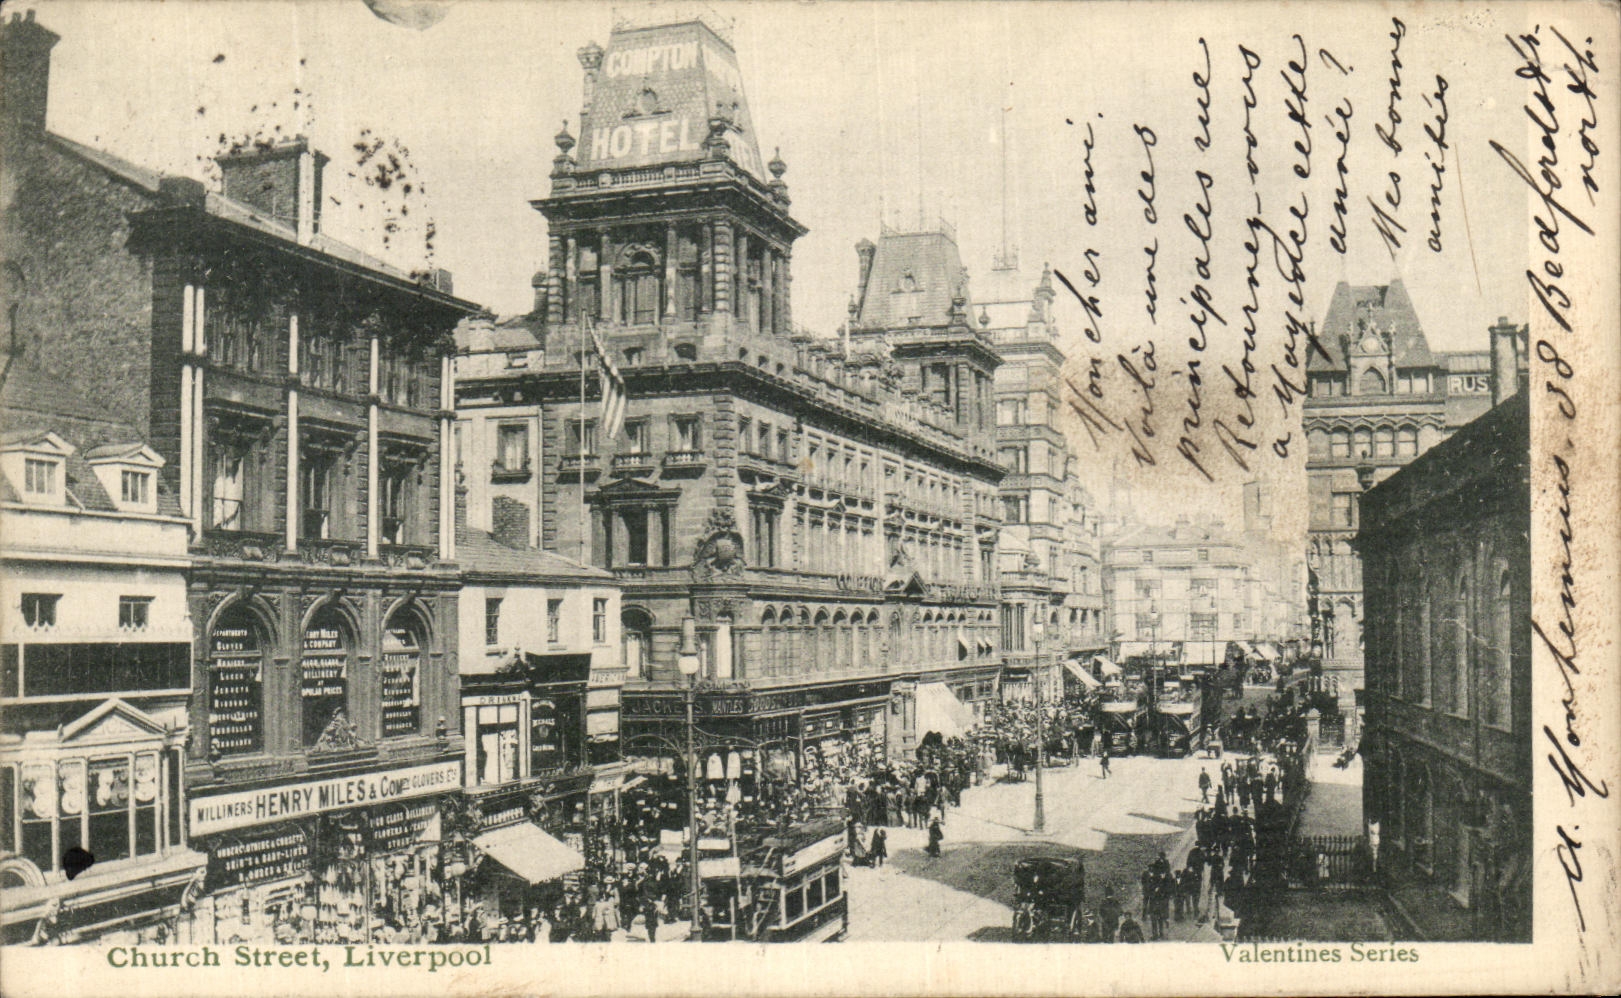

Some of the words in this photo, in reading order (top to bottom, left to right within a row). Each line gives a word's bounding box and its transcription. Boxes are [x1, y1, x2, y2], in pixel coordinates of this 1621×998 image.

[606, 41, 698, 78] COMPTON
[1280, 34, 1312, 178] cette
[1375, 14, 1406, 155] bonnes
[590, 117, 700, 161] HOTEL
[1133, 123, 1157, 223] des
[1367, 170, 1402, 259] Mes
[1055, 249, 1102, 342] cher
[1142, 239, 1157, 323] une
[1172, 171, 1227, 481] principales
[1119, 340, 1157, 465] Voilà
[197, 800, 253, 824] MILLINERS
[256, 787, 313, 820] HENRY
[319, 779, 365, 809] MILES
[369, 783, 377, 799] &
[412, 770, 444, 789] GLOVERS
